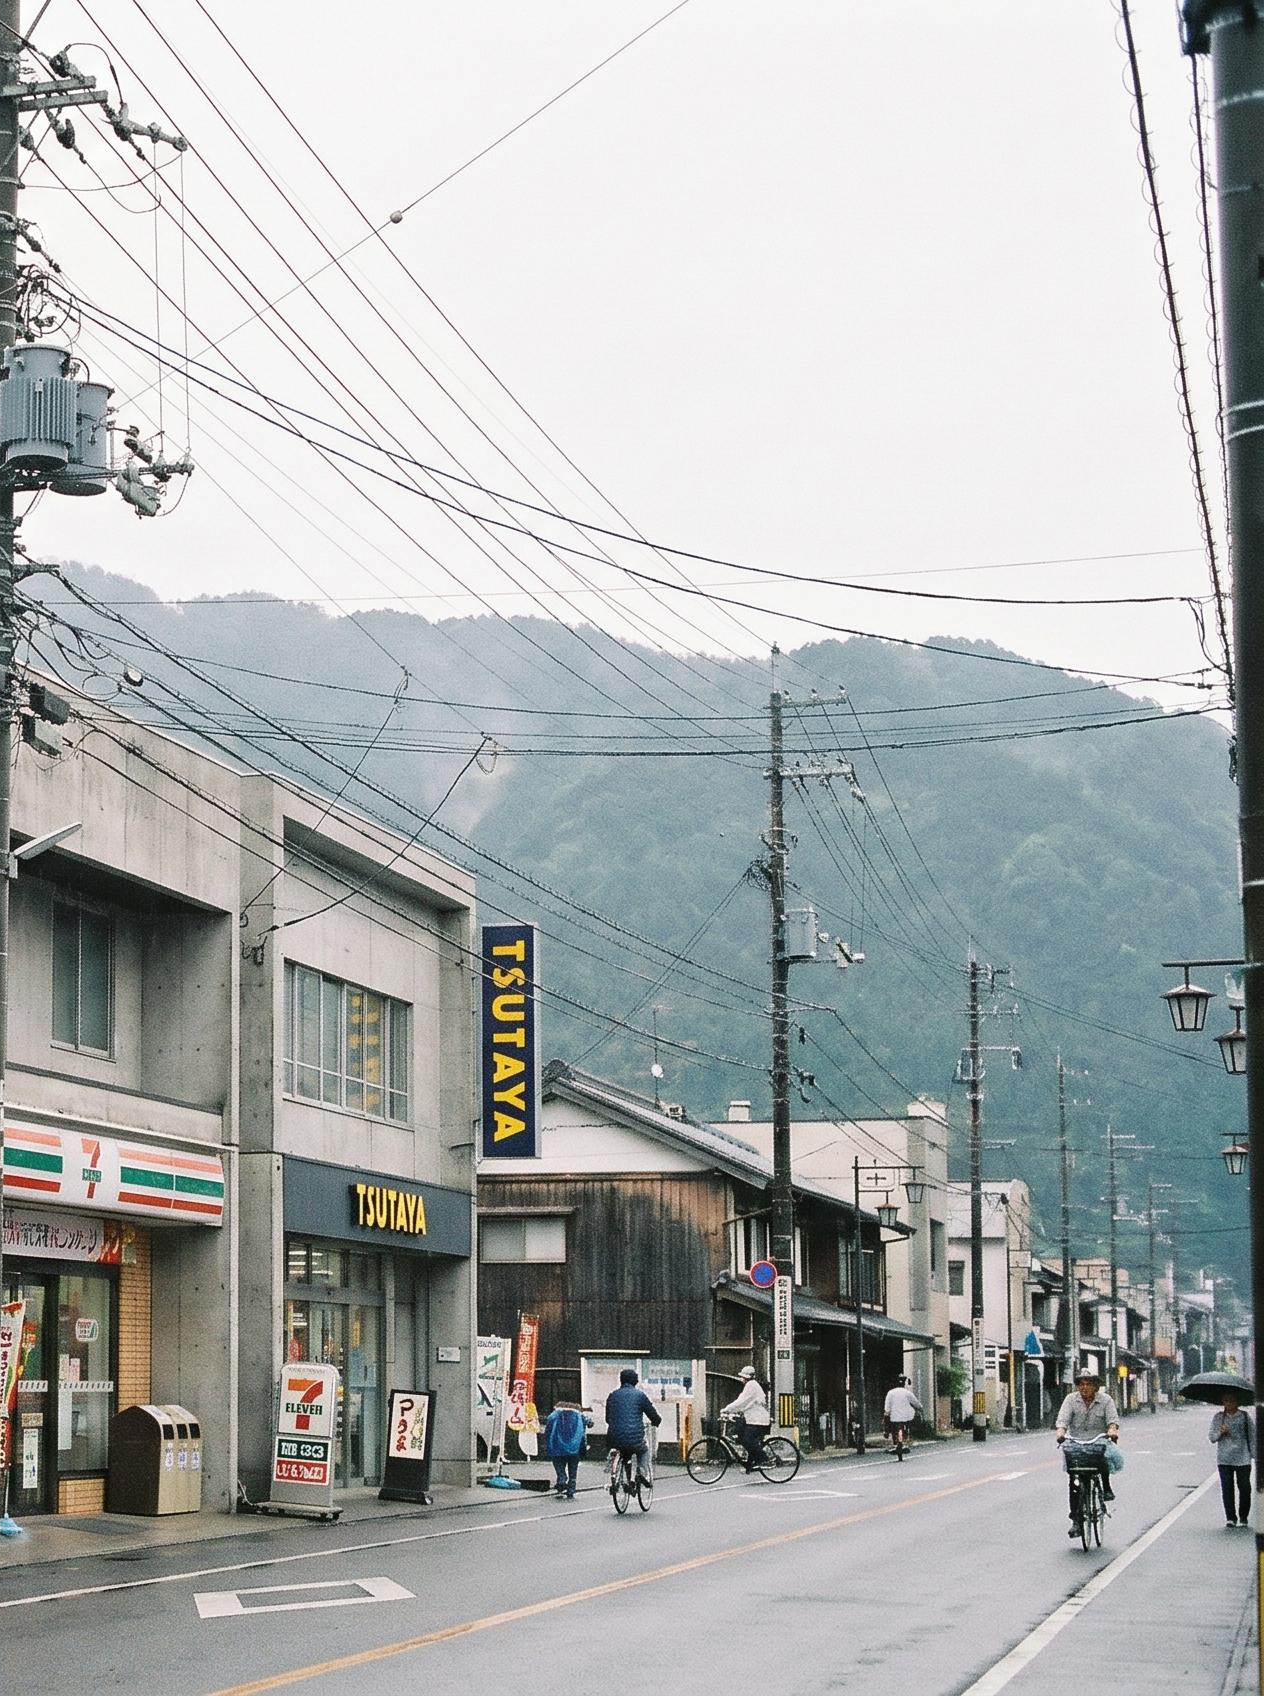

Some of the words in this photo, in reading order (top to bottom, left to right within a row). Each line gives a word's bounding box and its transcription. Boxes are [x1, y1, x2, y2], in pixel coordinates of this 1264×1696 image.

[492, 940, 526, 1142] TSUTAYA
[356, 1183, 427, 1235] TSUTAYA
[288, 1378, 324, 1430] 7
